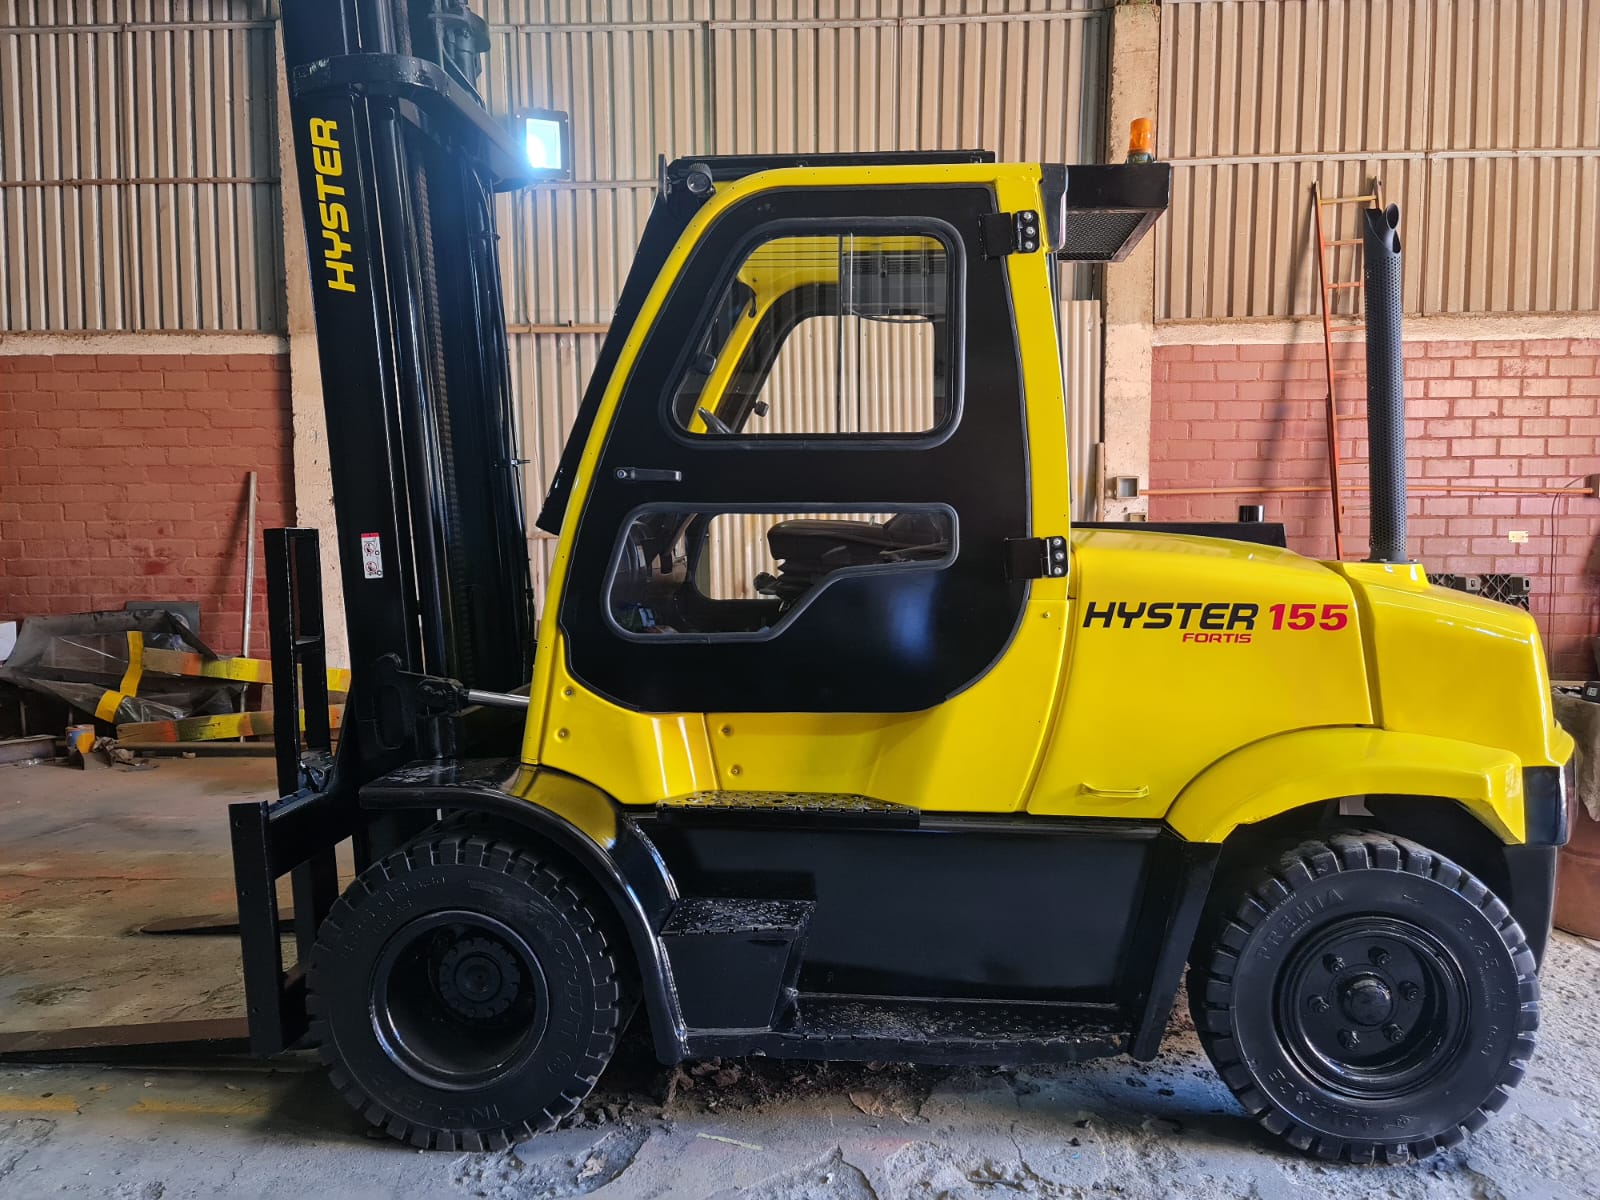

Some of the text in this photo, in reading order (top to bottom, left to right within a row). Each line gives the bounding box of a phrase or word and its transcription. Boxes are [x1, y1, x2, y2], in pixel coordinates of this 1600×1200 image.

[309, 117, 357, 293] HYSTER
[1082, 602, 1349, 631] HYSTER 155
[1182, 633, 1252, 644] FORTIS
